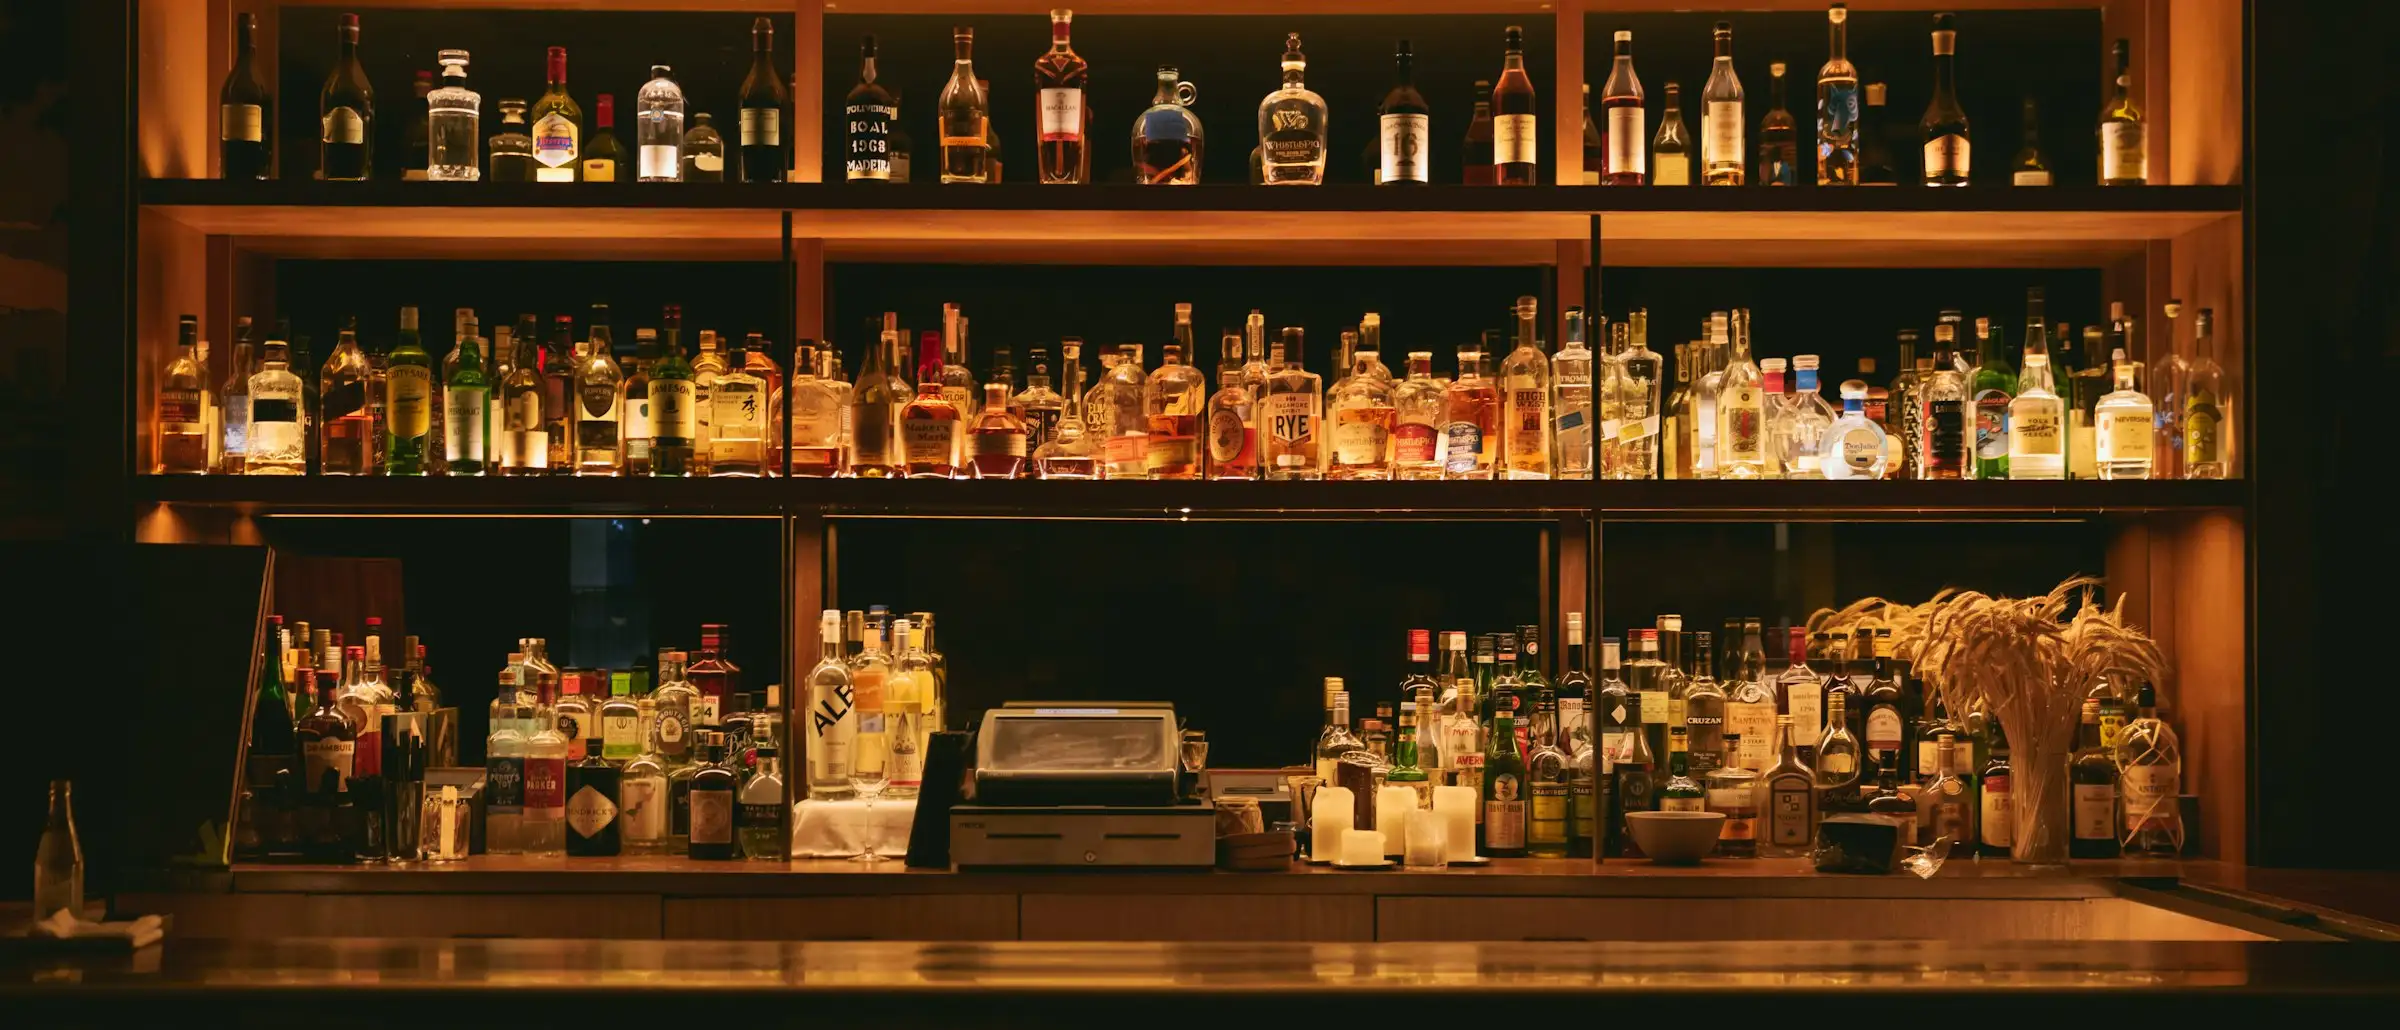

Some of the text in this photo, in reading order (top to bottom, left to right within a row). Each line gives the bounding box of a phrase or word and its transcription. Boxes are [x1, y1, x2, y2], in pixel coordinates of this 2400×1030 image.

[850, 121, 888, 134] BOAL
[851, 139, 886, 153] 1968
[1394, 132, 1418, 156] 16
[846, 159, 891, 172] MADEIRA
[651, 382, 692, 396] JAMESON
[1516, 391, 1545, 401] HIGH
[1275, 415, 1309, 440] RYE
[692, 706, 713, 718] 24
[655, 708, 683, 733] PLYMOUTH
[1687, 717, 1722, 725] CRUZAN
[306, 743, 353, 752] DRAMBUIE
[1455, 756, 1483, 766] AVERN
[527, 780, 556, 790] PARKER
